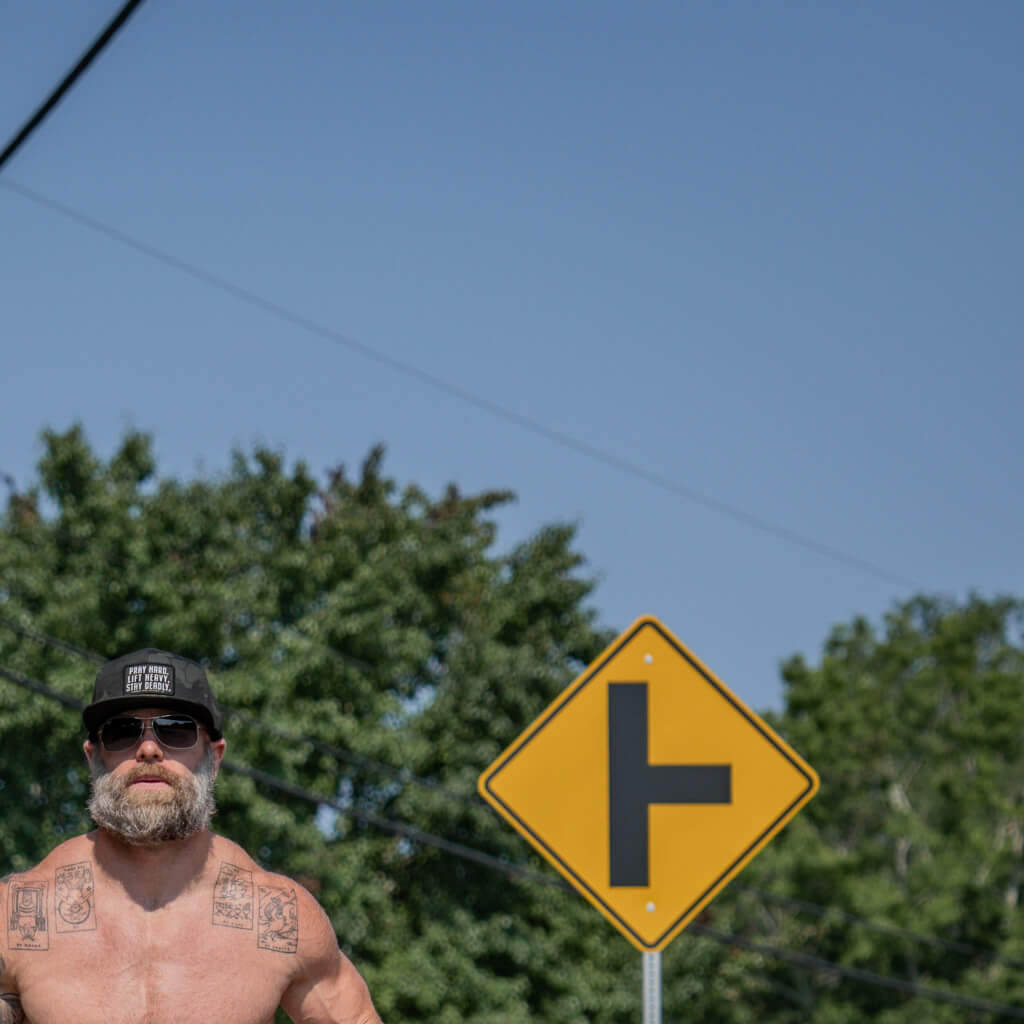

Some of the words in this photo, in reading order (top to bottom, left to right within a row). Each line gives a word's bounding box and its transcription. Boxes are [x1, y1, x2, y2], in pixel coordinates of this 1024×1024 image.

[129, 665, 147, 674] PRAY
[127, 674, 142, 684] LIFT
[126, 682, 143, 692] STAY
